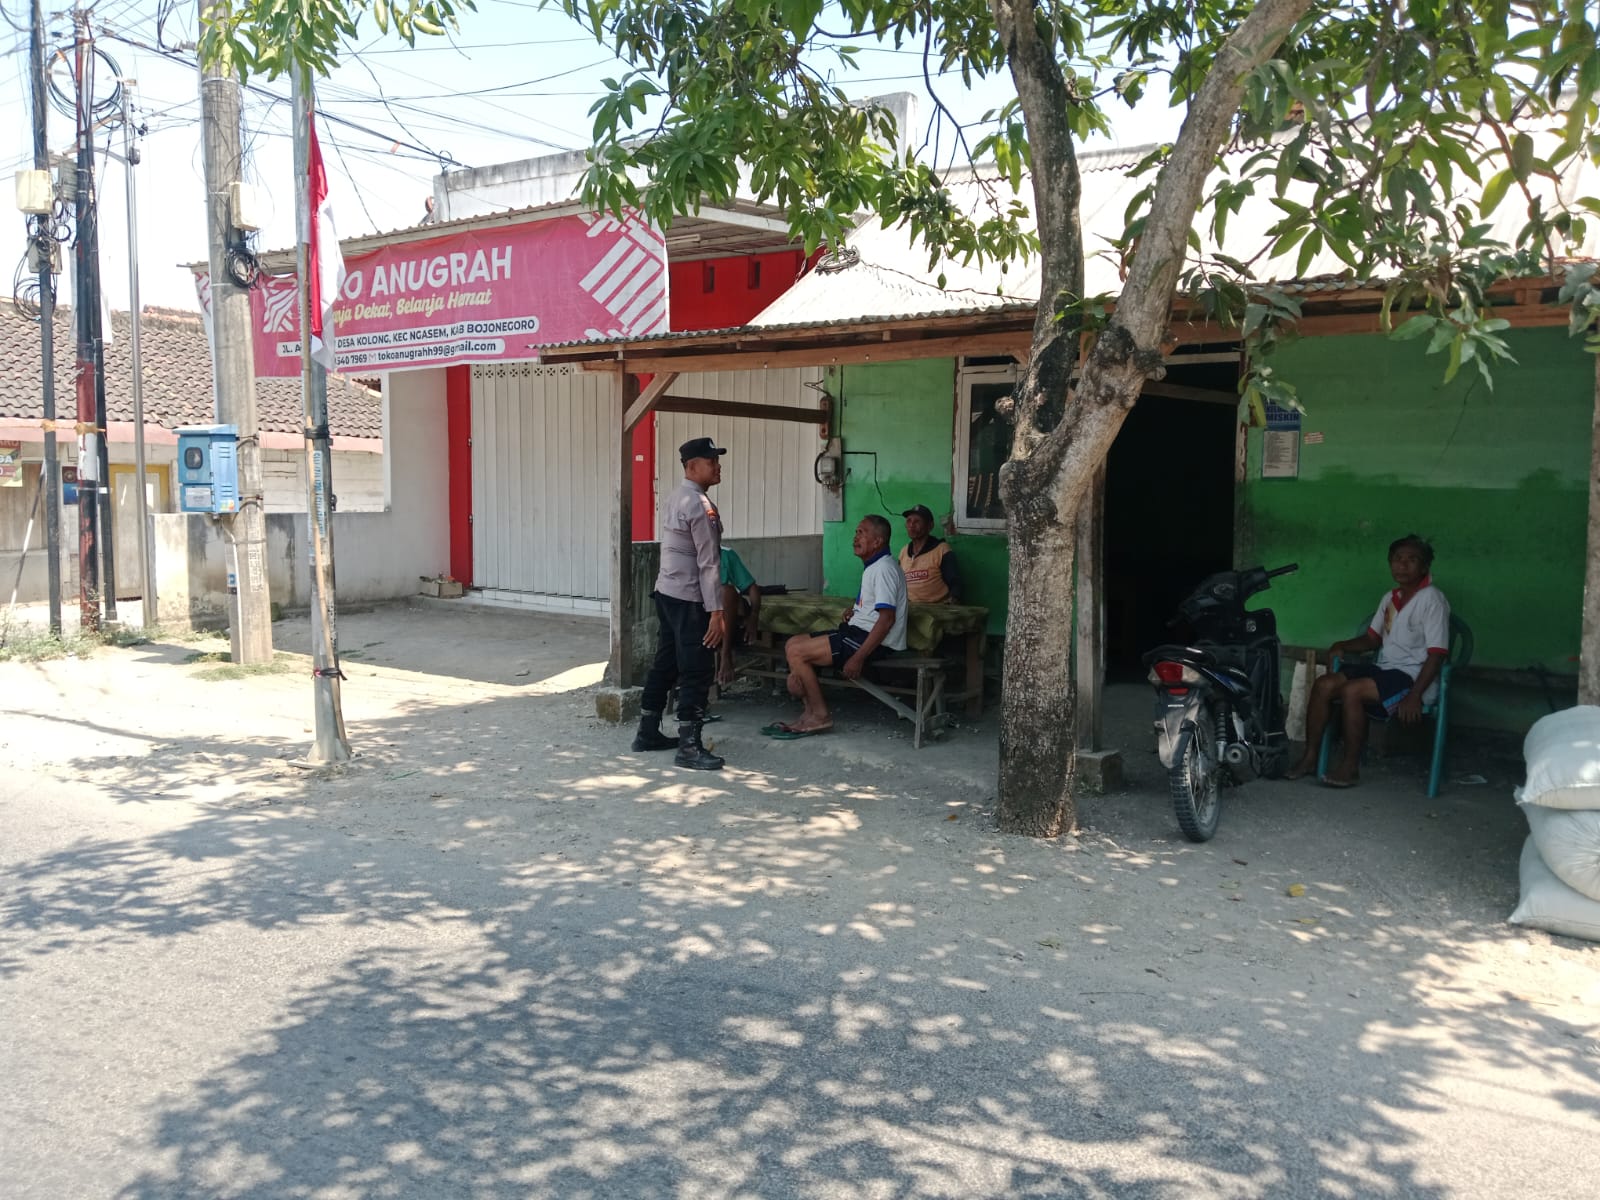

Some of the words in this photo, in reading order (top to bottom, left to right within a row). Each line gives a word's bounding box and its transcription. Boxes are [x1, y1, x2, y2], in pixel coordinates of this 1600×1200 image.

[371, 245, 512, 298] ANUGRAH
[354, 302, 392, 320] Dekat,
[396, 293, 444, 318] Belanja
[447, 288, 492, 309] Hemat
[337, 337, 355, 348] DESA
[356, 334, 391, 346] KOLONG,
[393, 332, 408, 343] KEC
[409, 328, 449, 341] NGASEM,
[466, 319, 535, 334] BOJONEGORO
[351, 353, 368, 364] 7969
